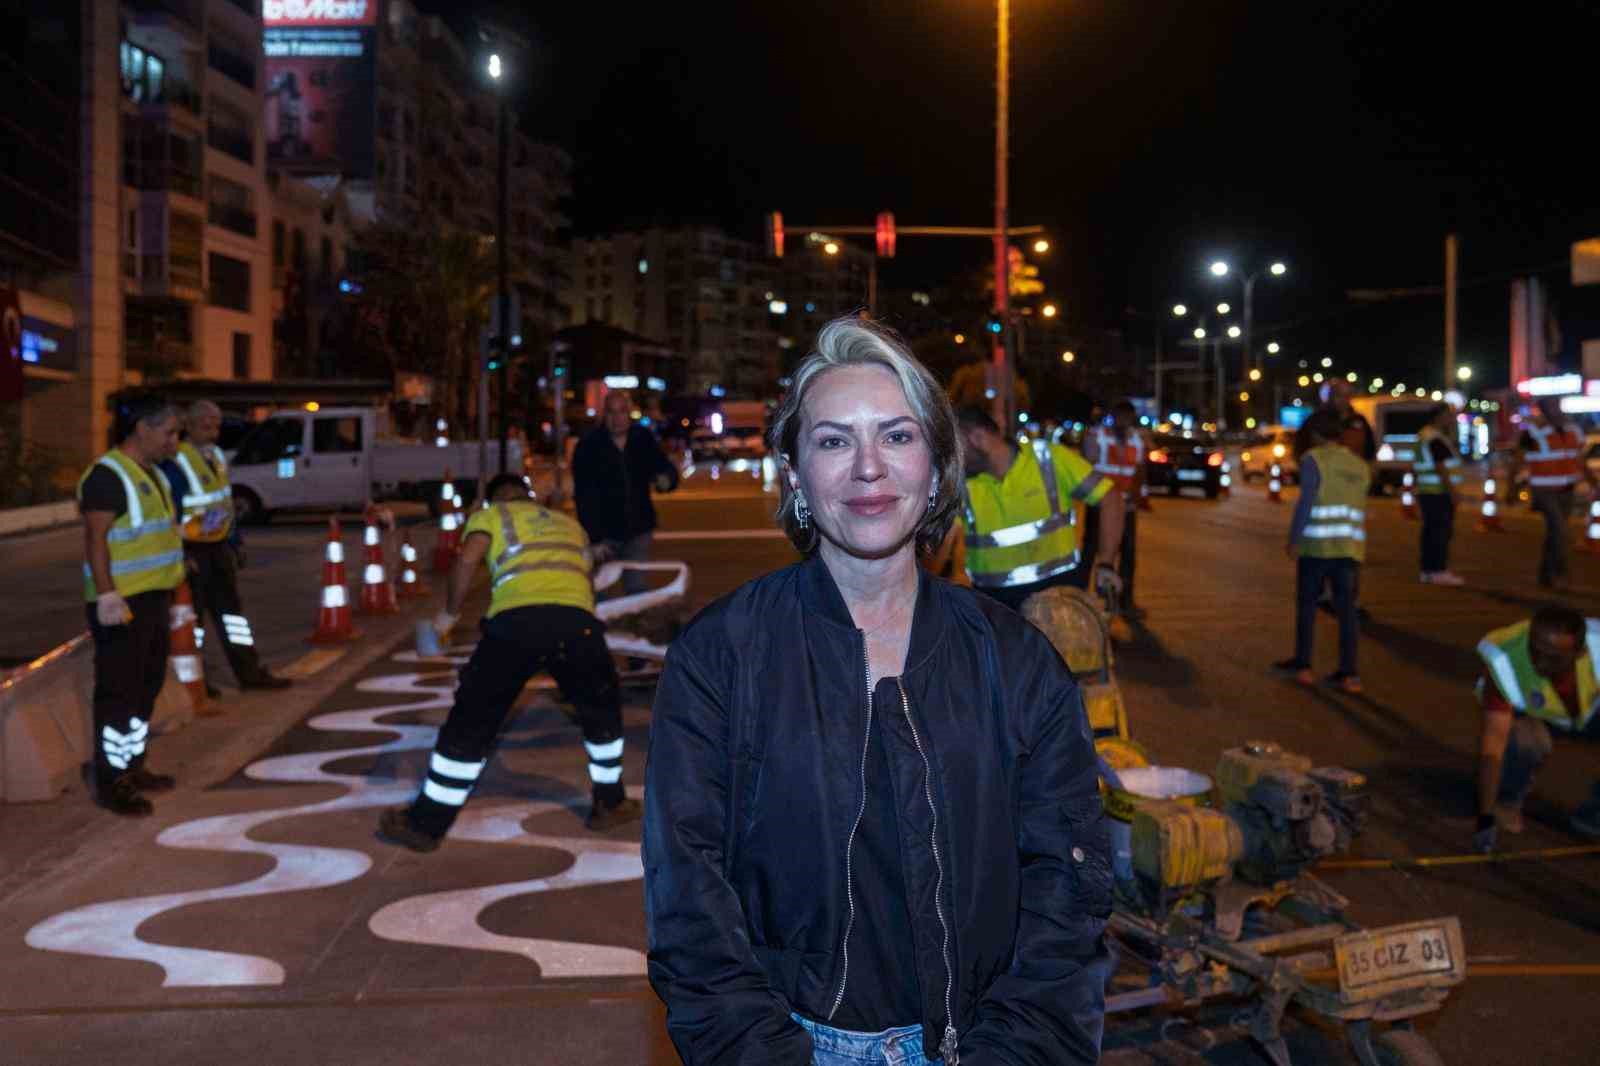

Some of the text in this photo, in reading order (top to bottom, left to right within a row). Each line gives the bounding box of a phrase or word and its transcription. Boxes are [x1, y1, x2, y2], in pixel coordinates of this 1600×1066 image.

[1348, 938, 1445, 975] 35 CIZ 03
